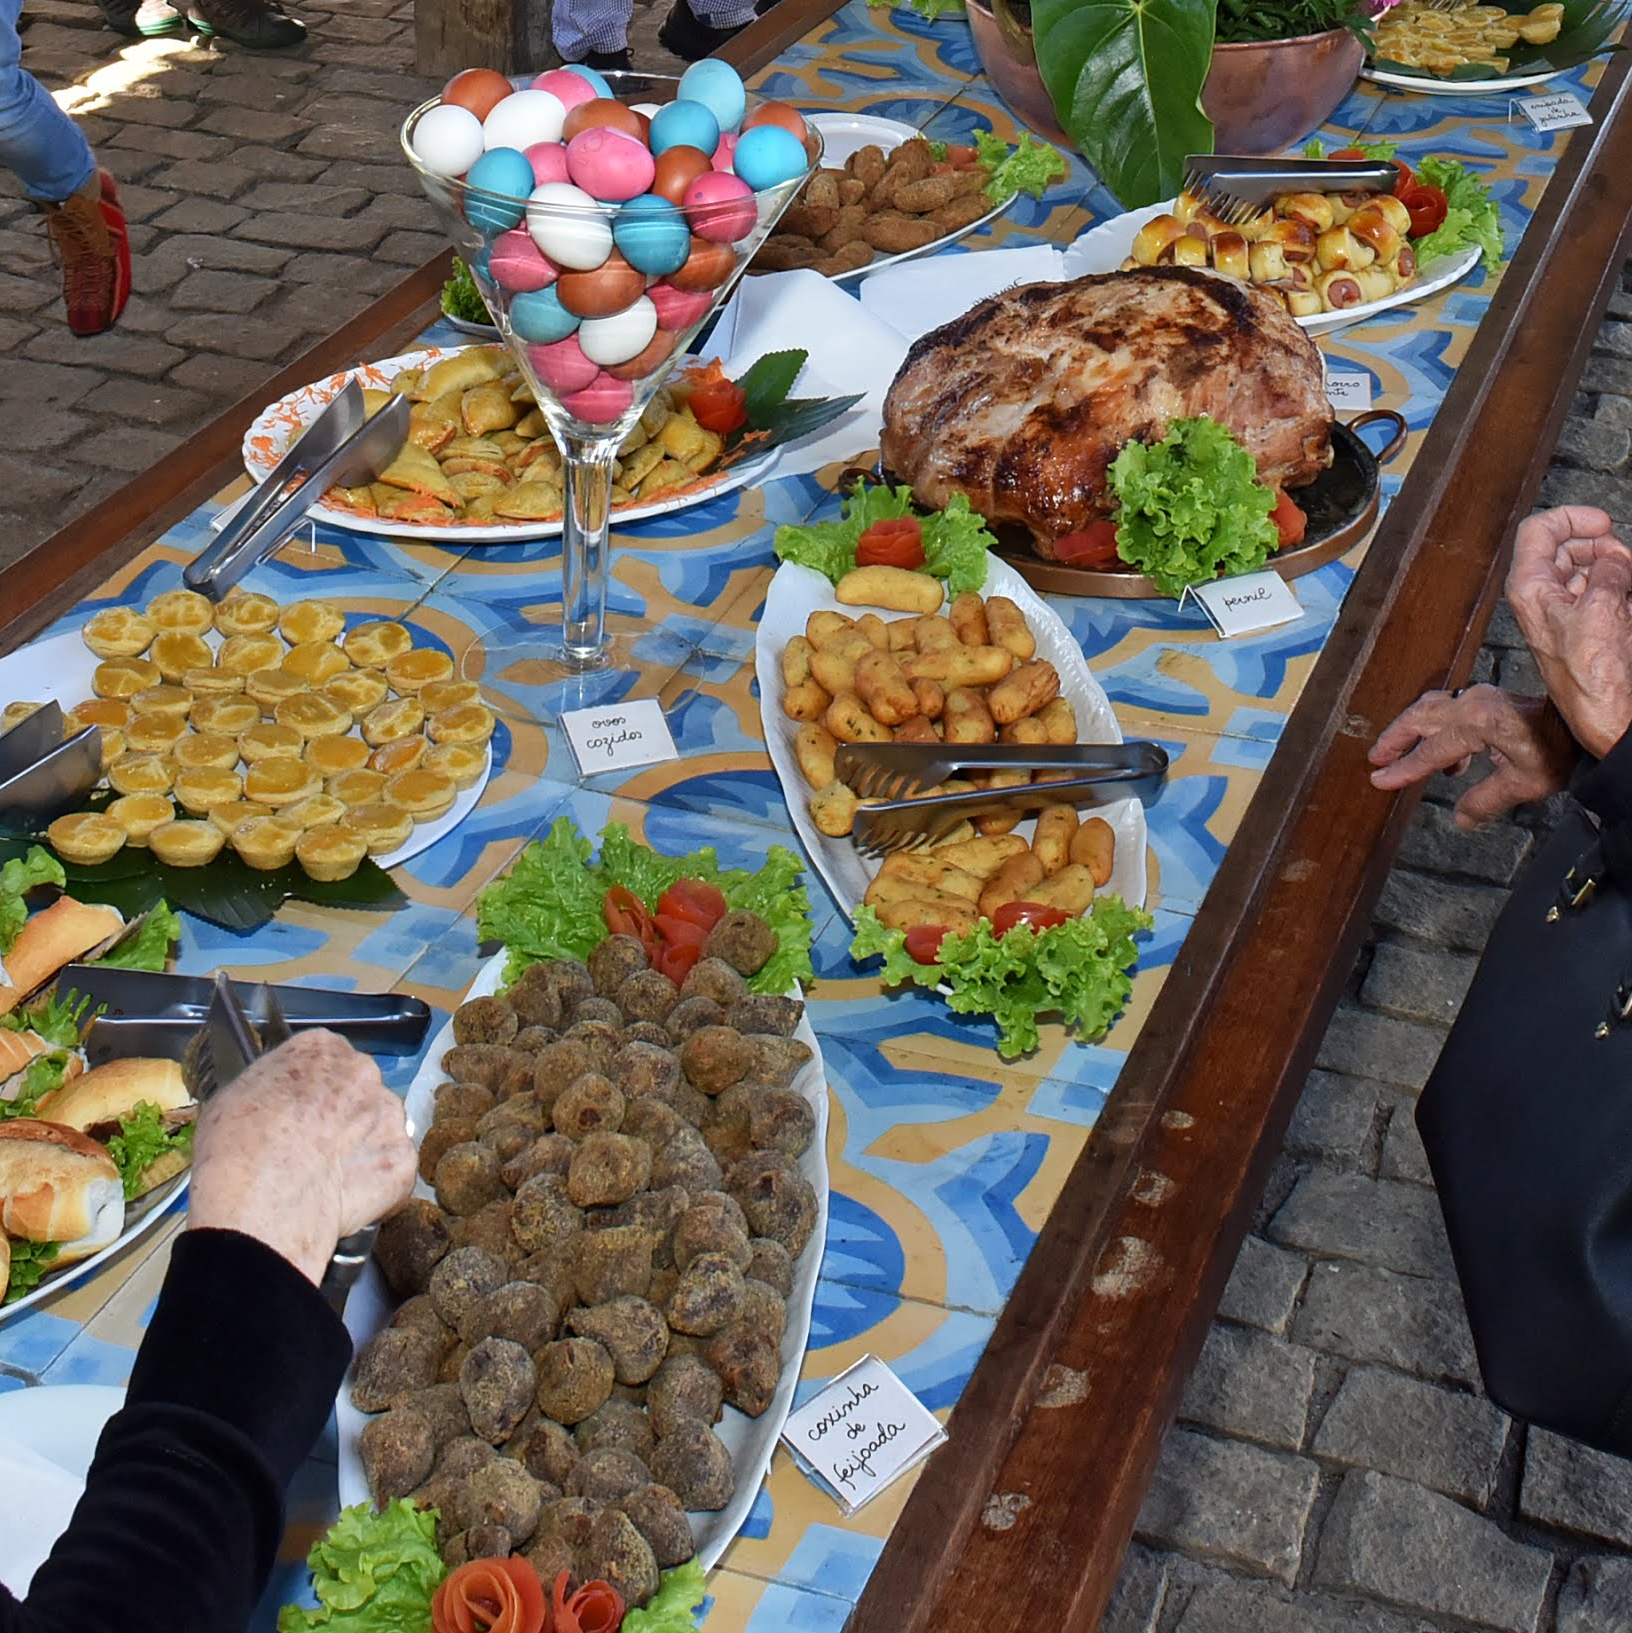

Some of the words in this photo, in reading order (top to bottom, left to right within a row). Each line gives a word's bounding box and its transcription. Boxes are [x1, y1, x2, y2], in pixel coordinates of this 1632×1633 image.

[1223, 586, 1272, 612] pernil
[591, 716, 627, 729] ovos
[586, 729, 643, 757] cozidos
[808, 1382, 879, 1442] coxinha
[846, 1422, 866, 1440] de
[833, 1421, 907, 1490] feijoada
